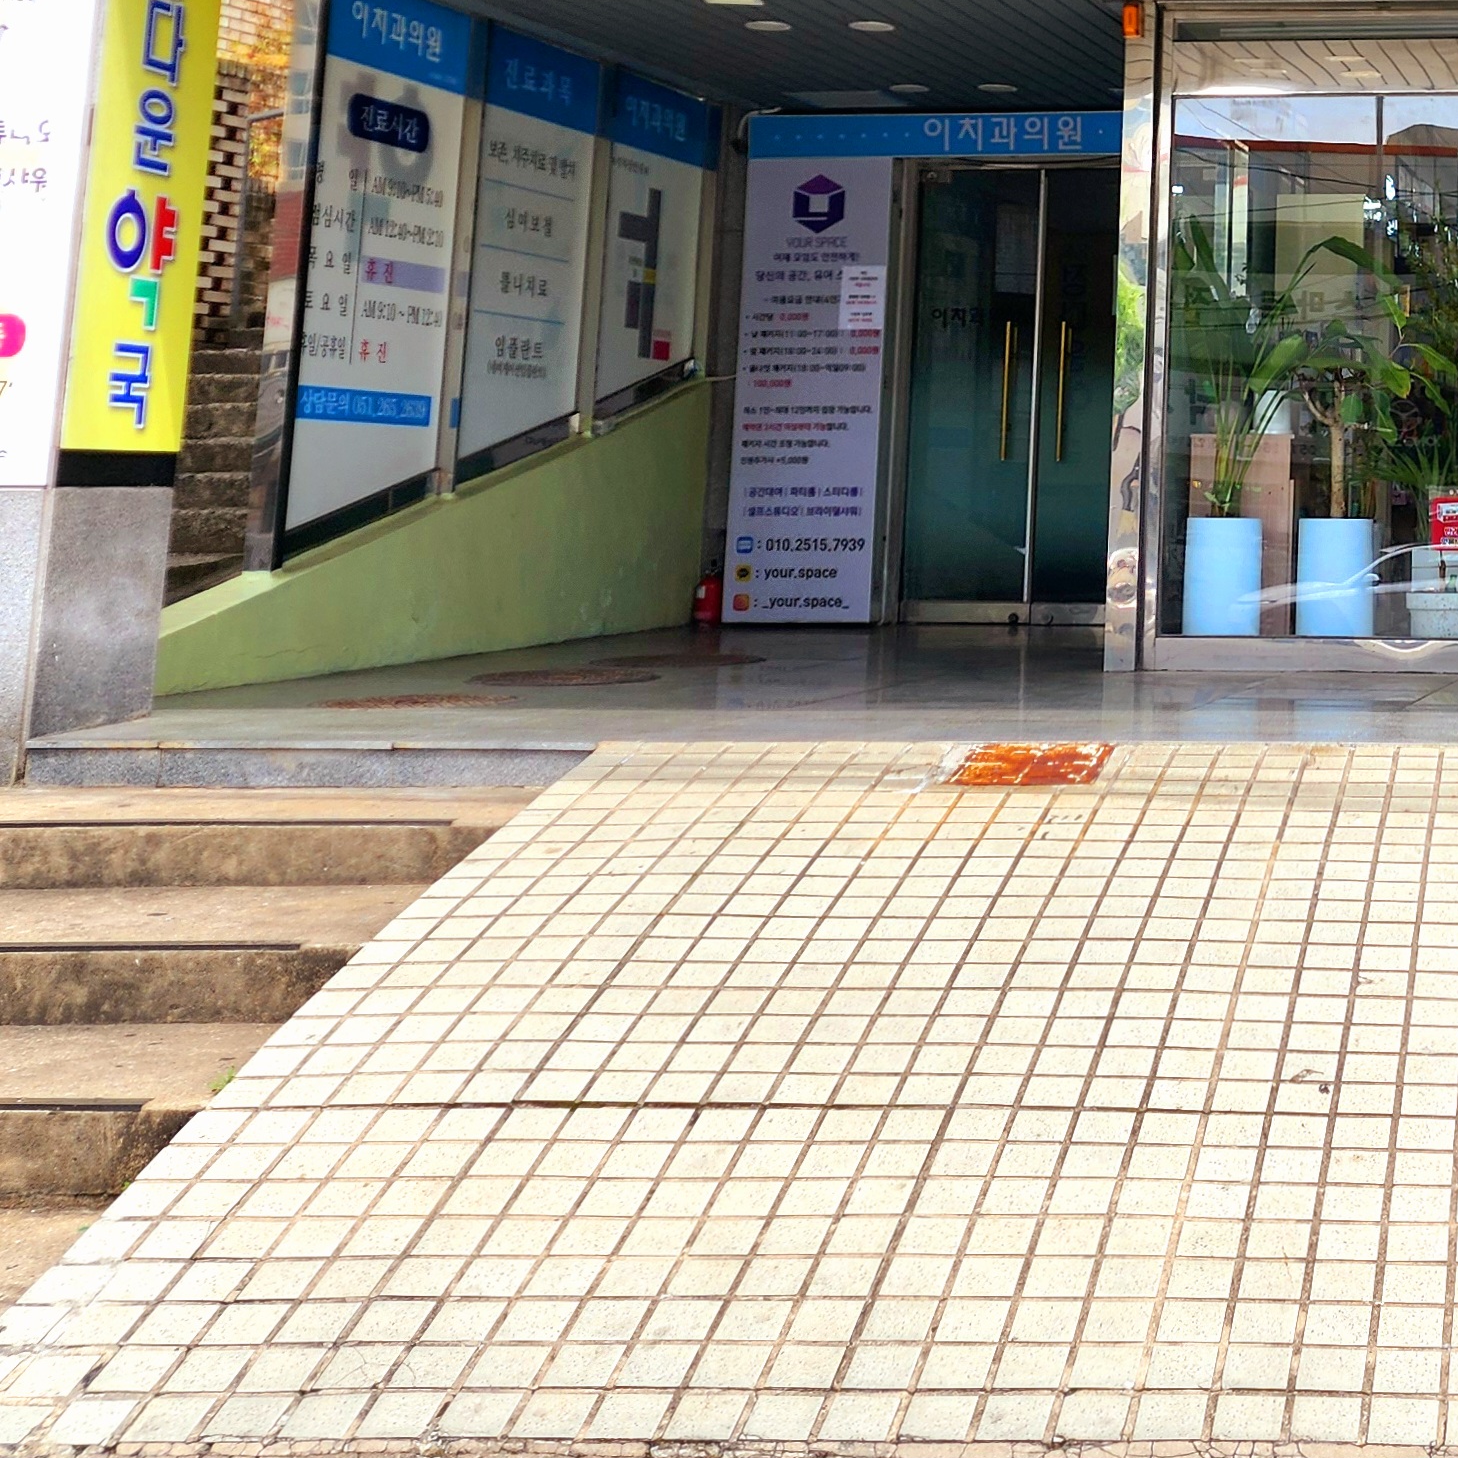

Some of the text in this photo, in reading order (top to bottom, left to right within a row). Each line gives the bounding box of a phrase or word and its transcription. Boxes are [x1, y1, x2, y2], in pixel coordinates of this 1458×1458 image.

[352, 0, 442, 63] 이치과의원
[360, 104, 419, 144] 진료시간
[923, 115, 1082, 151] 이치과의원
[494, 335, 543, 360] 임플란트
[299, 388, 350, 416] 상담문의
[766, 537, 865, 552] 010.2515.7939
[764, 566, 837, 581] your.space
